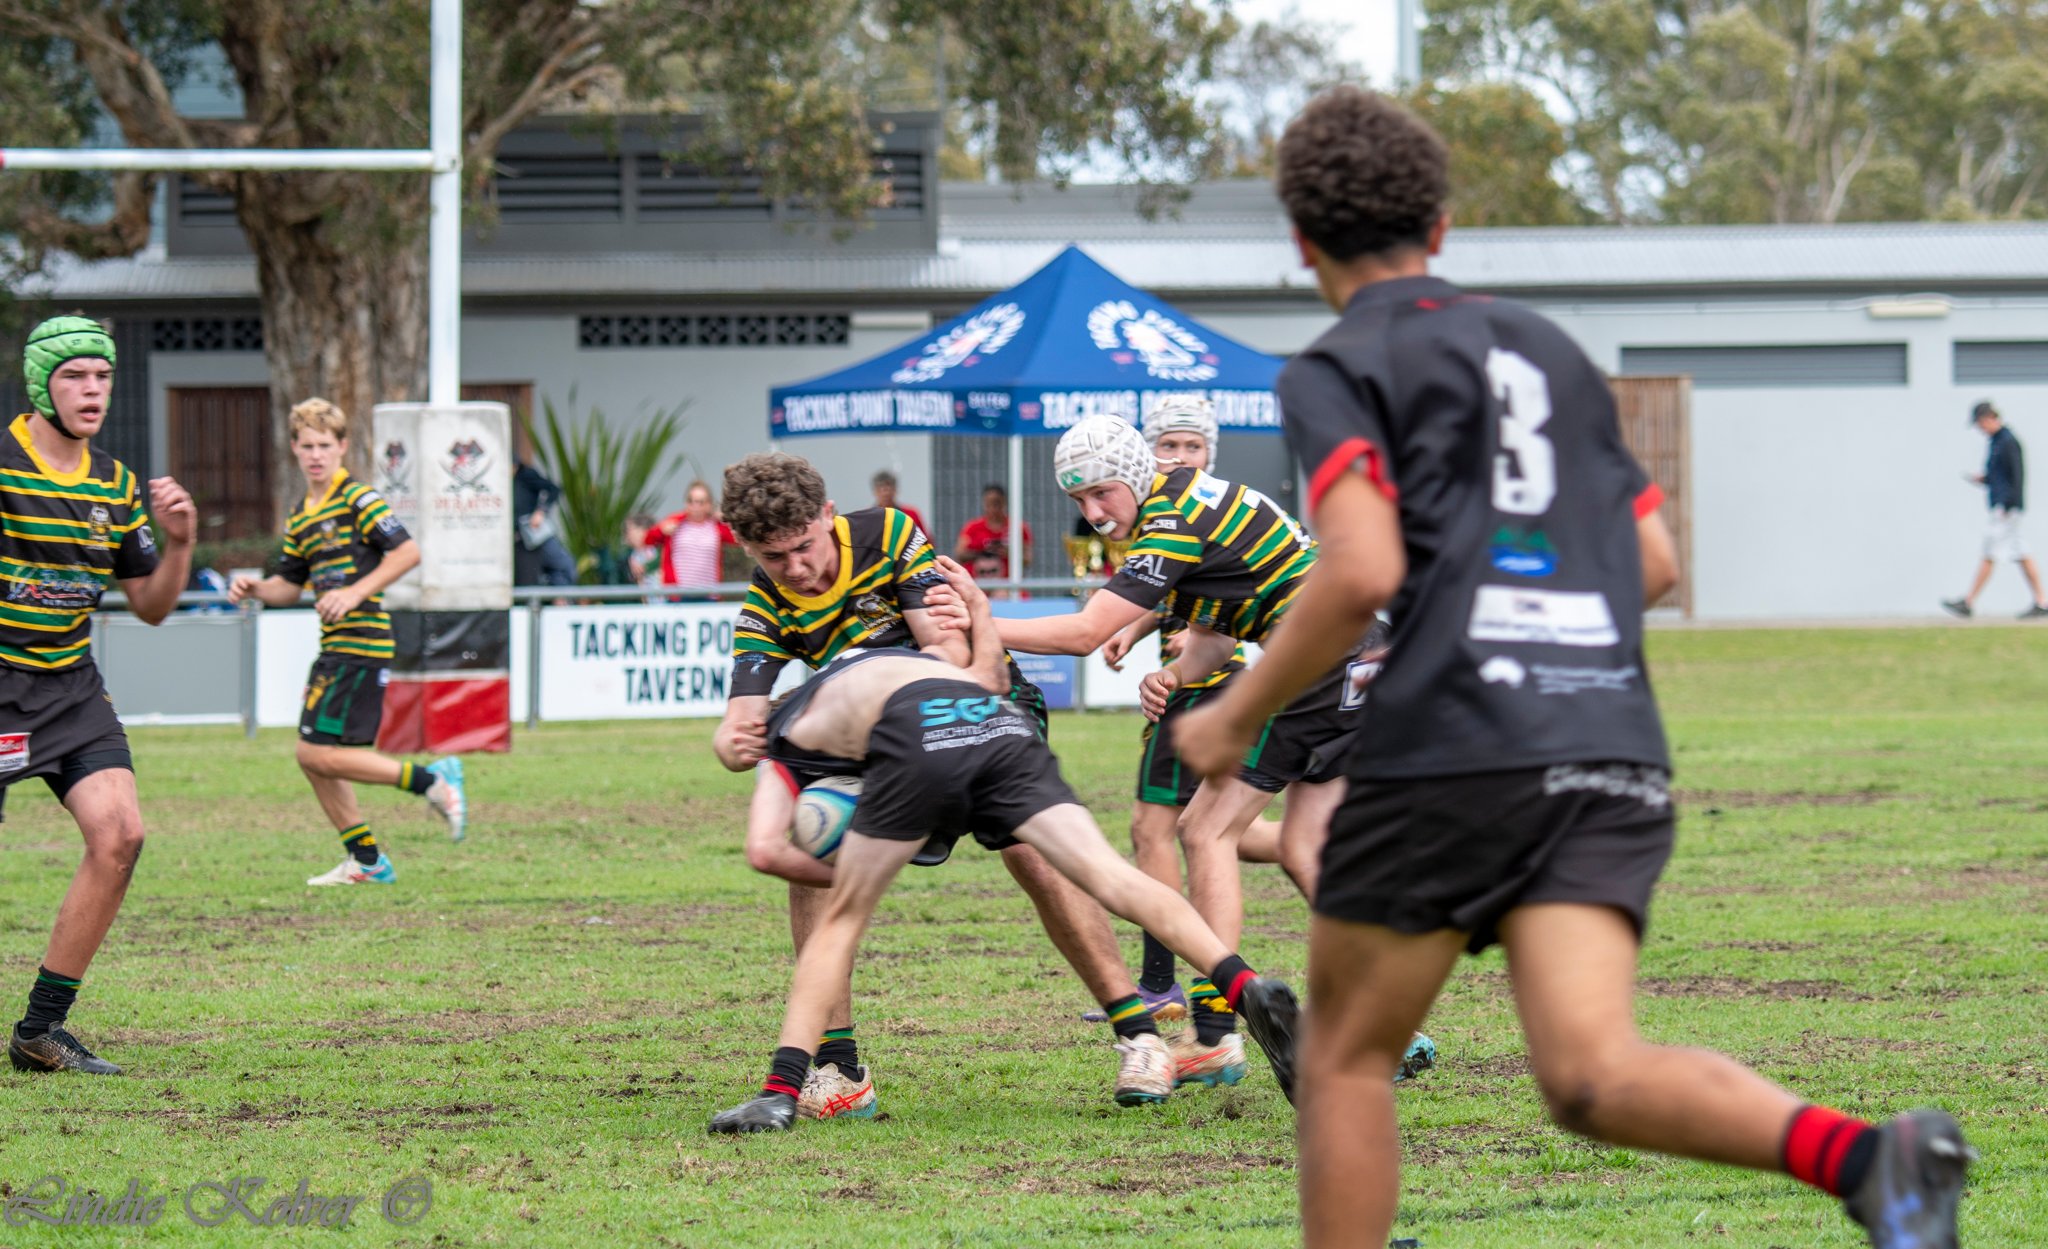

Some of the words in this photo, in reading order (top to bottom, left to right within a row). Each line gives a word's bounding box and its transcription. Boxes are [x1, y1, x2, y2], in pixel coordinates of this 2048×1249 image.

[1486, 347, 1556, 515] 3
[570, 621, 689, 658] TACKING
[624, 667, 725, 704] TAVERN
